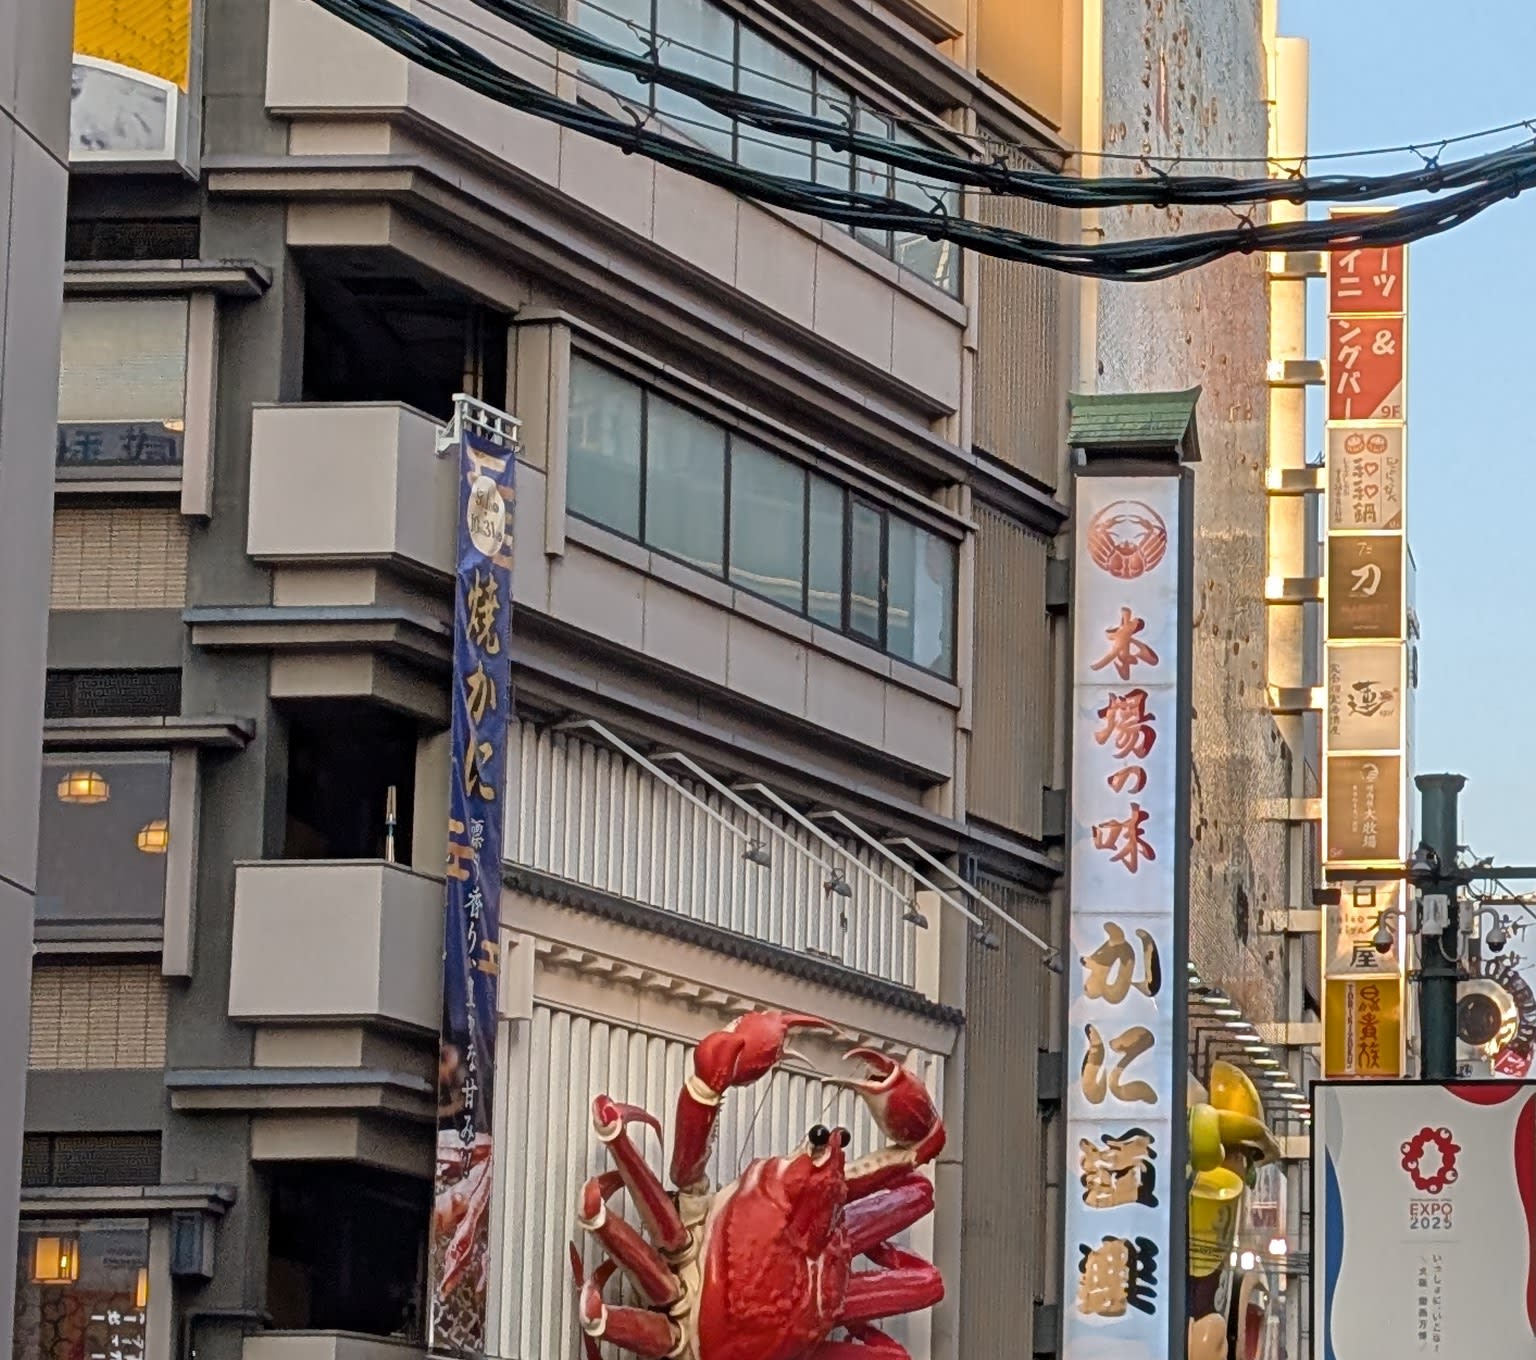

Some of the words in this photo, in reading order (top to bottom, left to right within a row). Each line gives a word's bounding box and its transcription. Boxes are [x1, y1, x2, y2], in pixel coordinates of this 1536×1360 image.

[466, 568, 500, 801] 焼かに
[1089, 606, 1159, 875] 本場の味
[1357, 984, 1380, 1070] 鳥貴族
[1077, 922, 1164, 1320] かに道楽
[1409, 1202, 1453, 1217] EXPO
[1409, 1216, 1453, 1230] 2025
